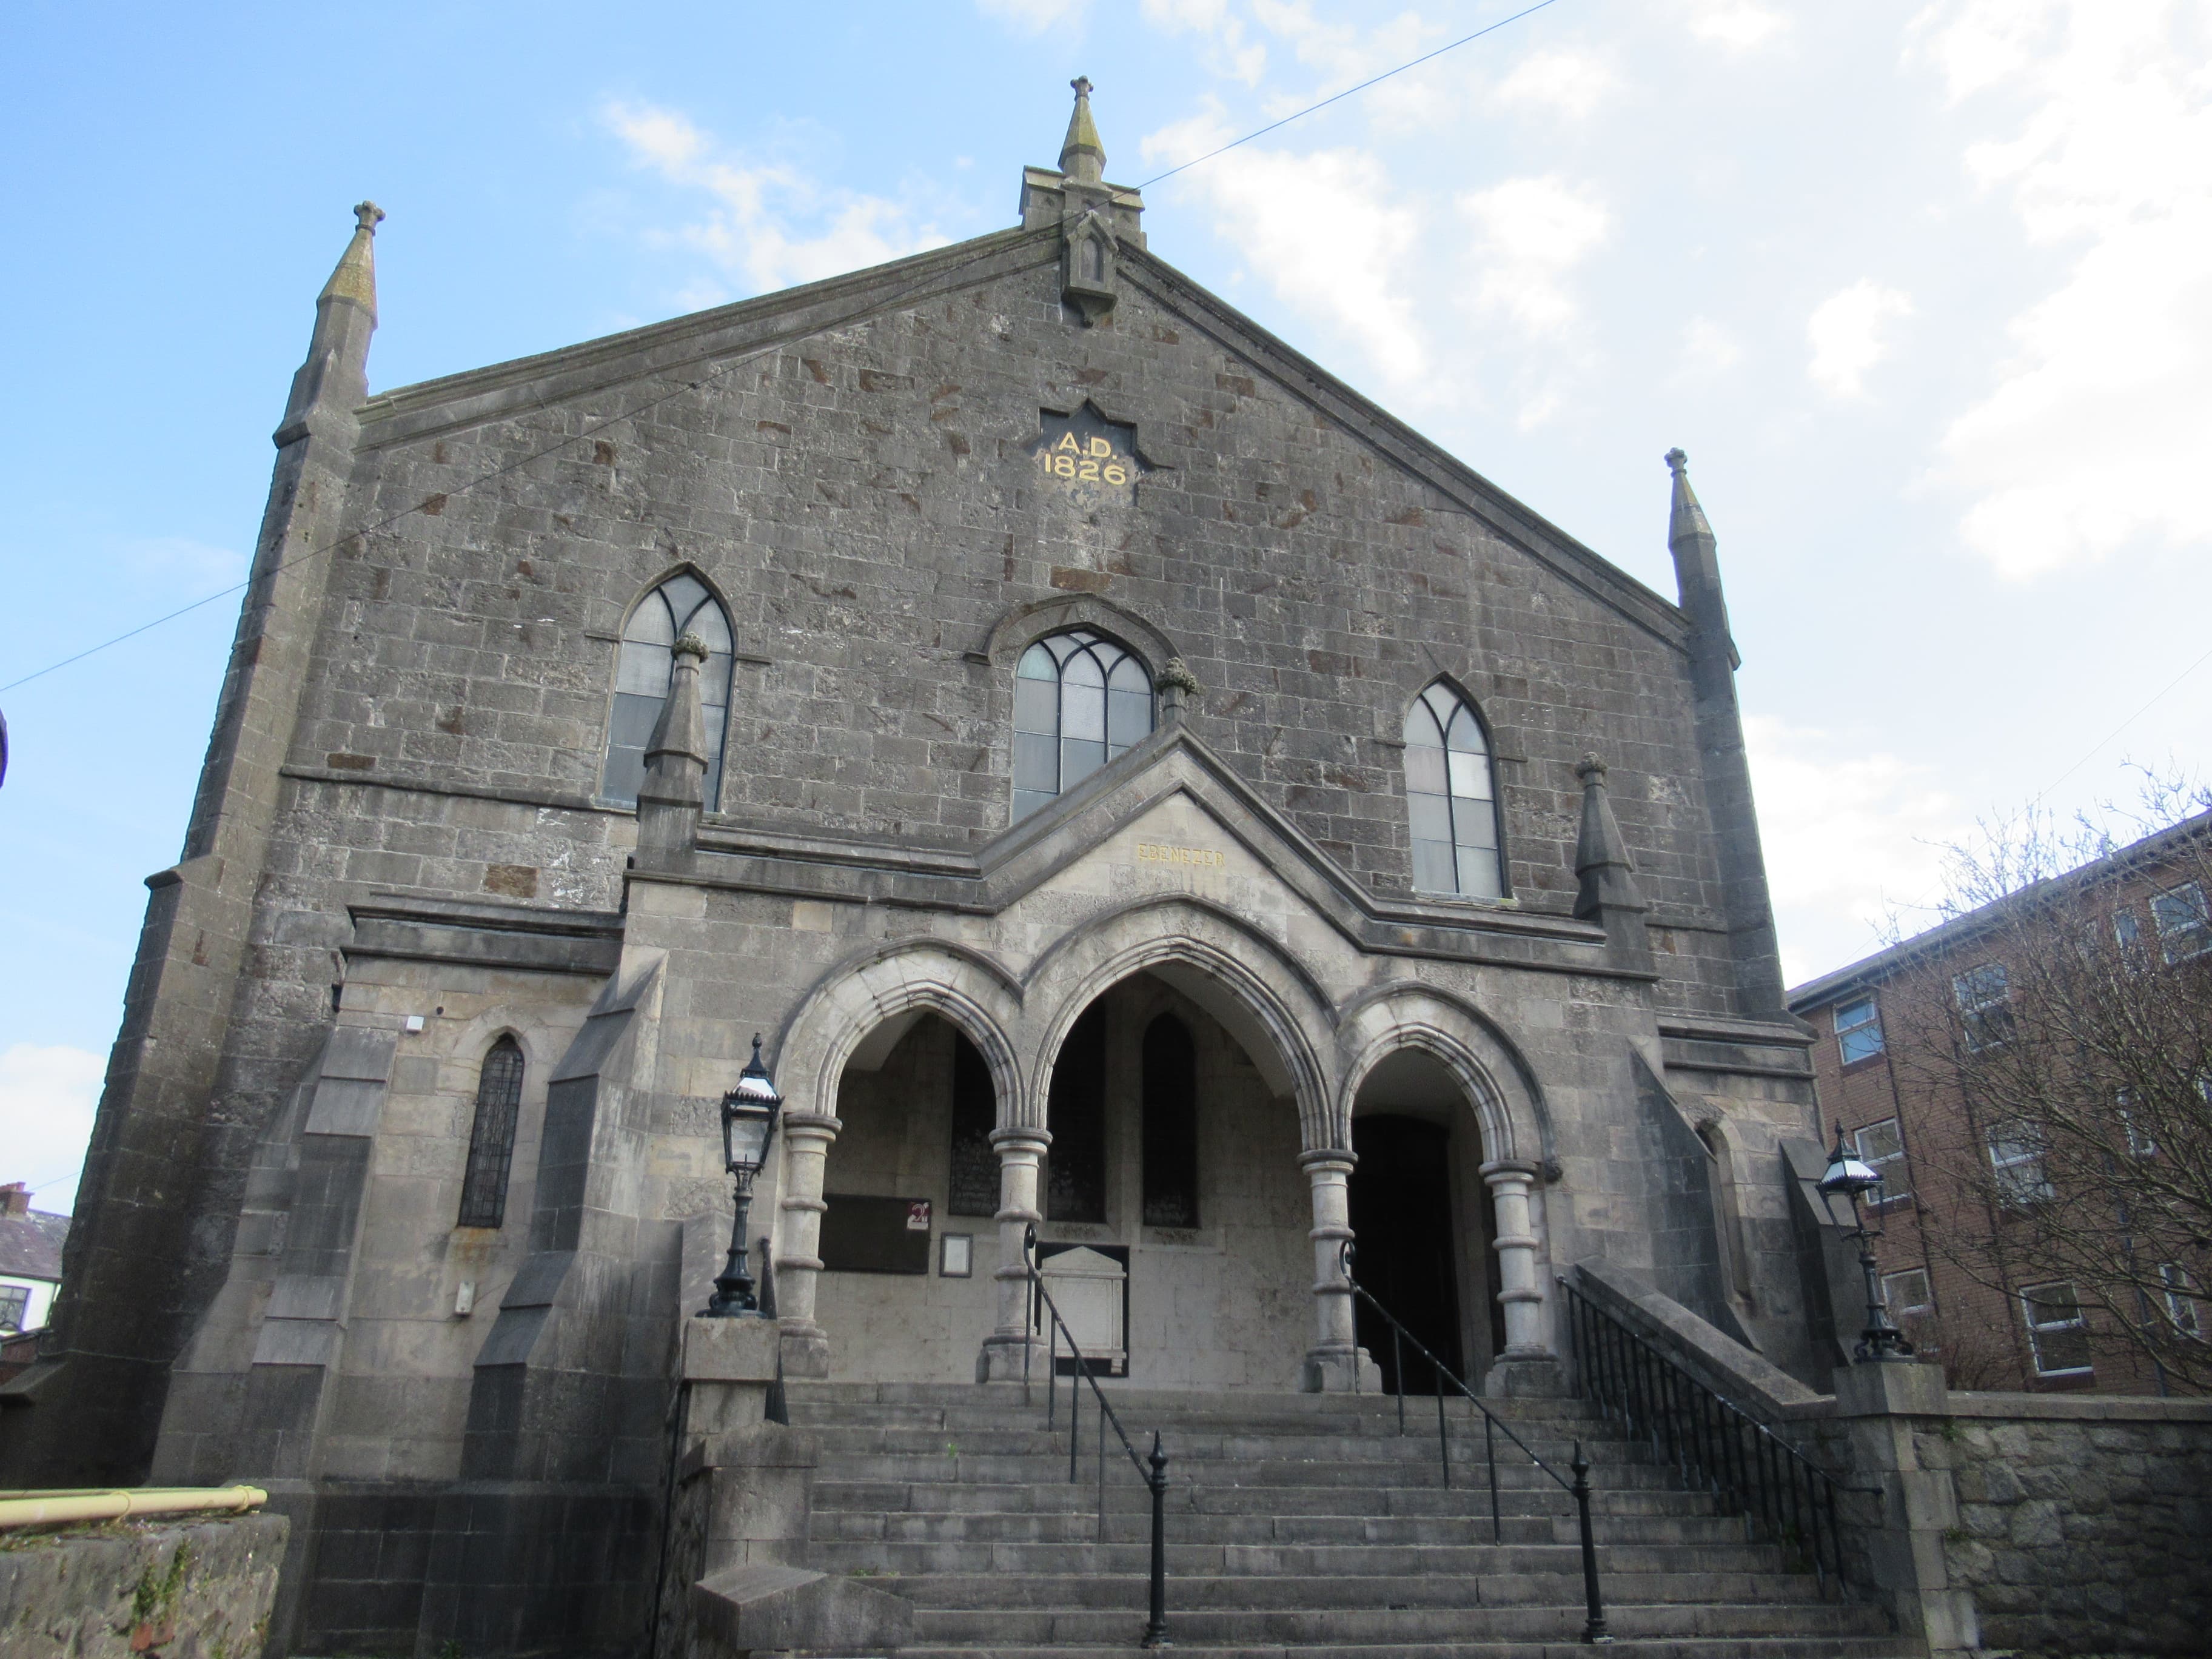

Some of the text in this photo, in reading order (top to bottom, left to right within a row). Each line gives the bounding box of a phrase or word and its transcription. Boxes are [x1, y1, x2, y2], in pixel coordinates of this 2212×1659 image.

[1058, 432, 1117, 460] A.D.
[1045, 454, 1126, 485] 1826
[1138, 843, 1225, 867] EBENEZER
